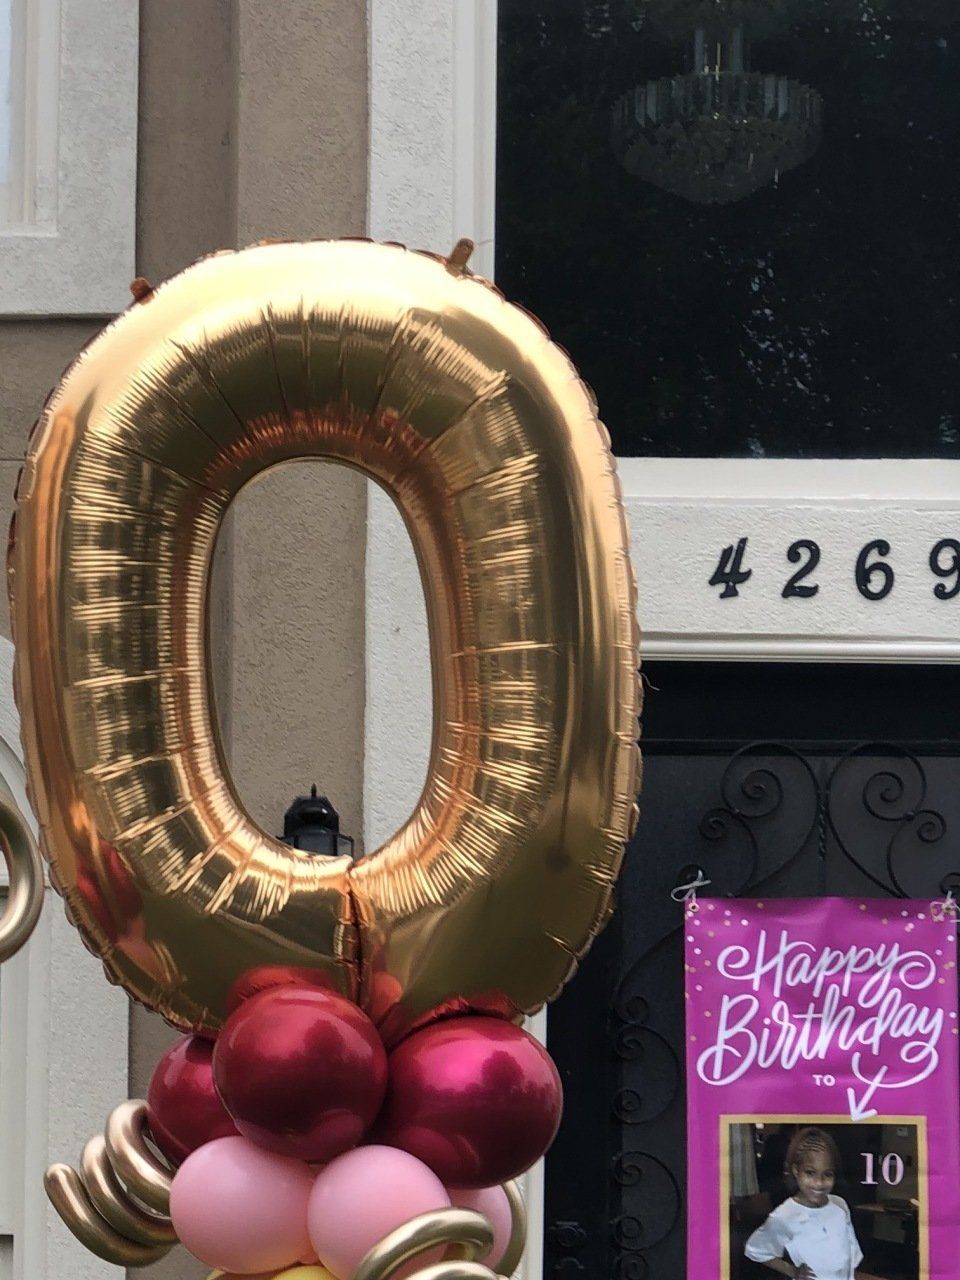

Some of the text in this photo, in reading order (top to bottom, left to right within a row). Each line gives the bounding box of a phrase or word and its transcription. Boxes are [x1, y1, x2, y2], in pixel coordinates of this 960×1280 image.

[708, 537, 960, 601] 4269
[716, 929, 937, 1009] Happy
[696, 984, 944, 1088] Birthday
[812, 1074, 836, 1086] TO
[859, 1152, 905, 1186] 10
